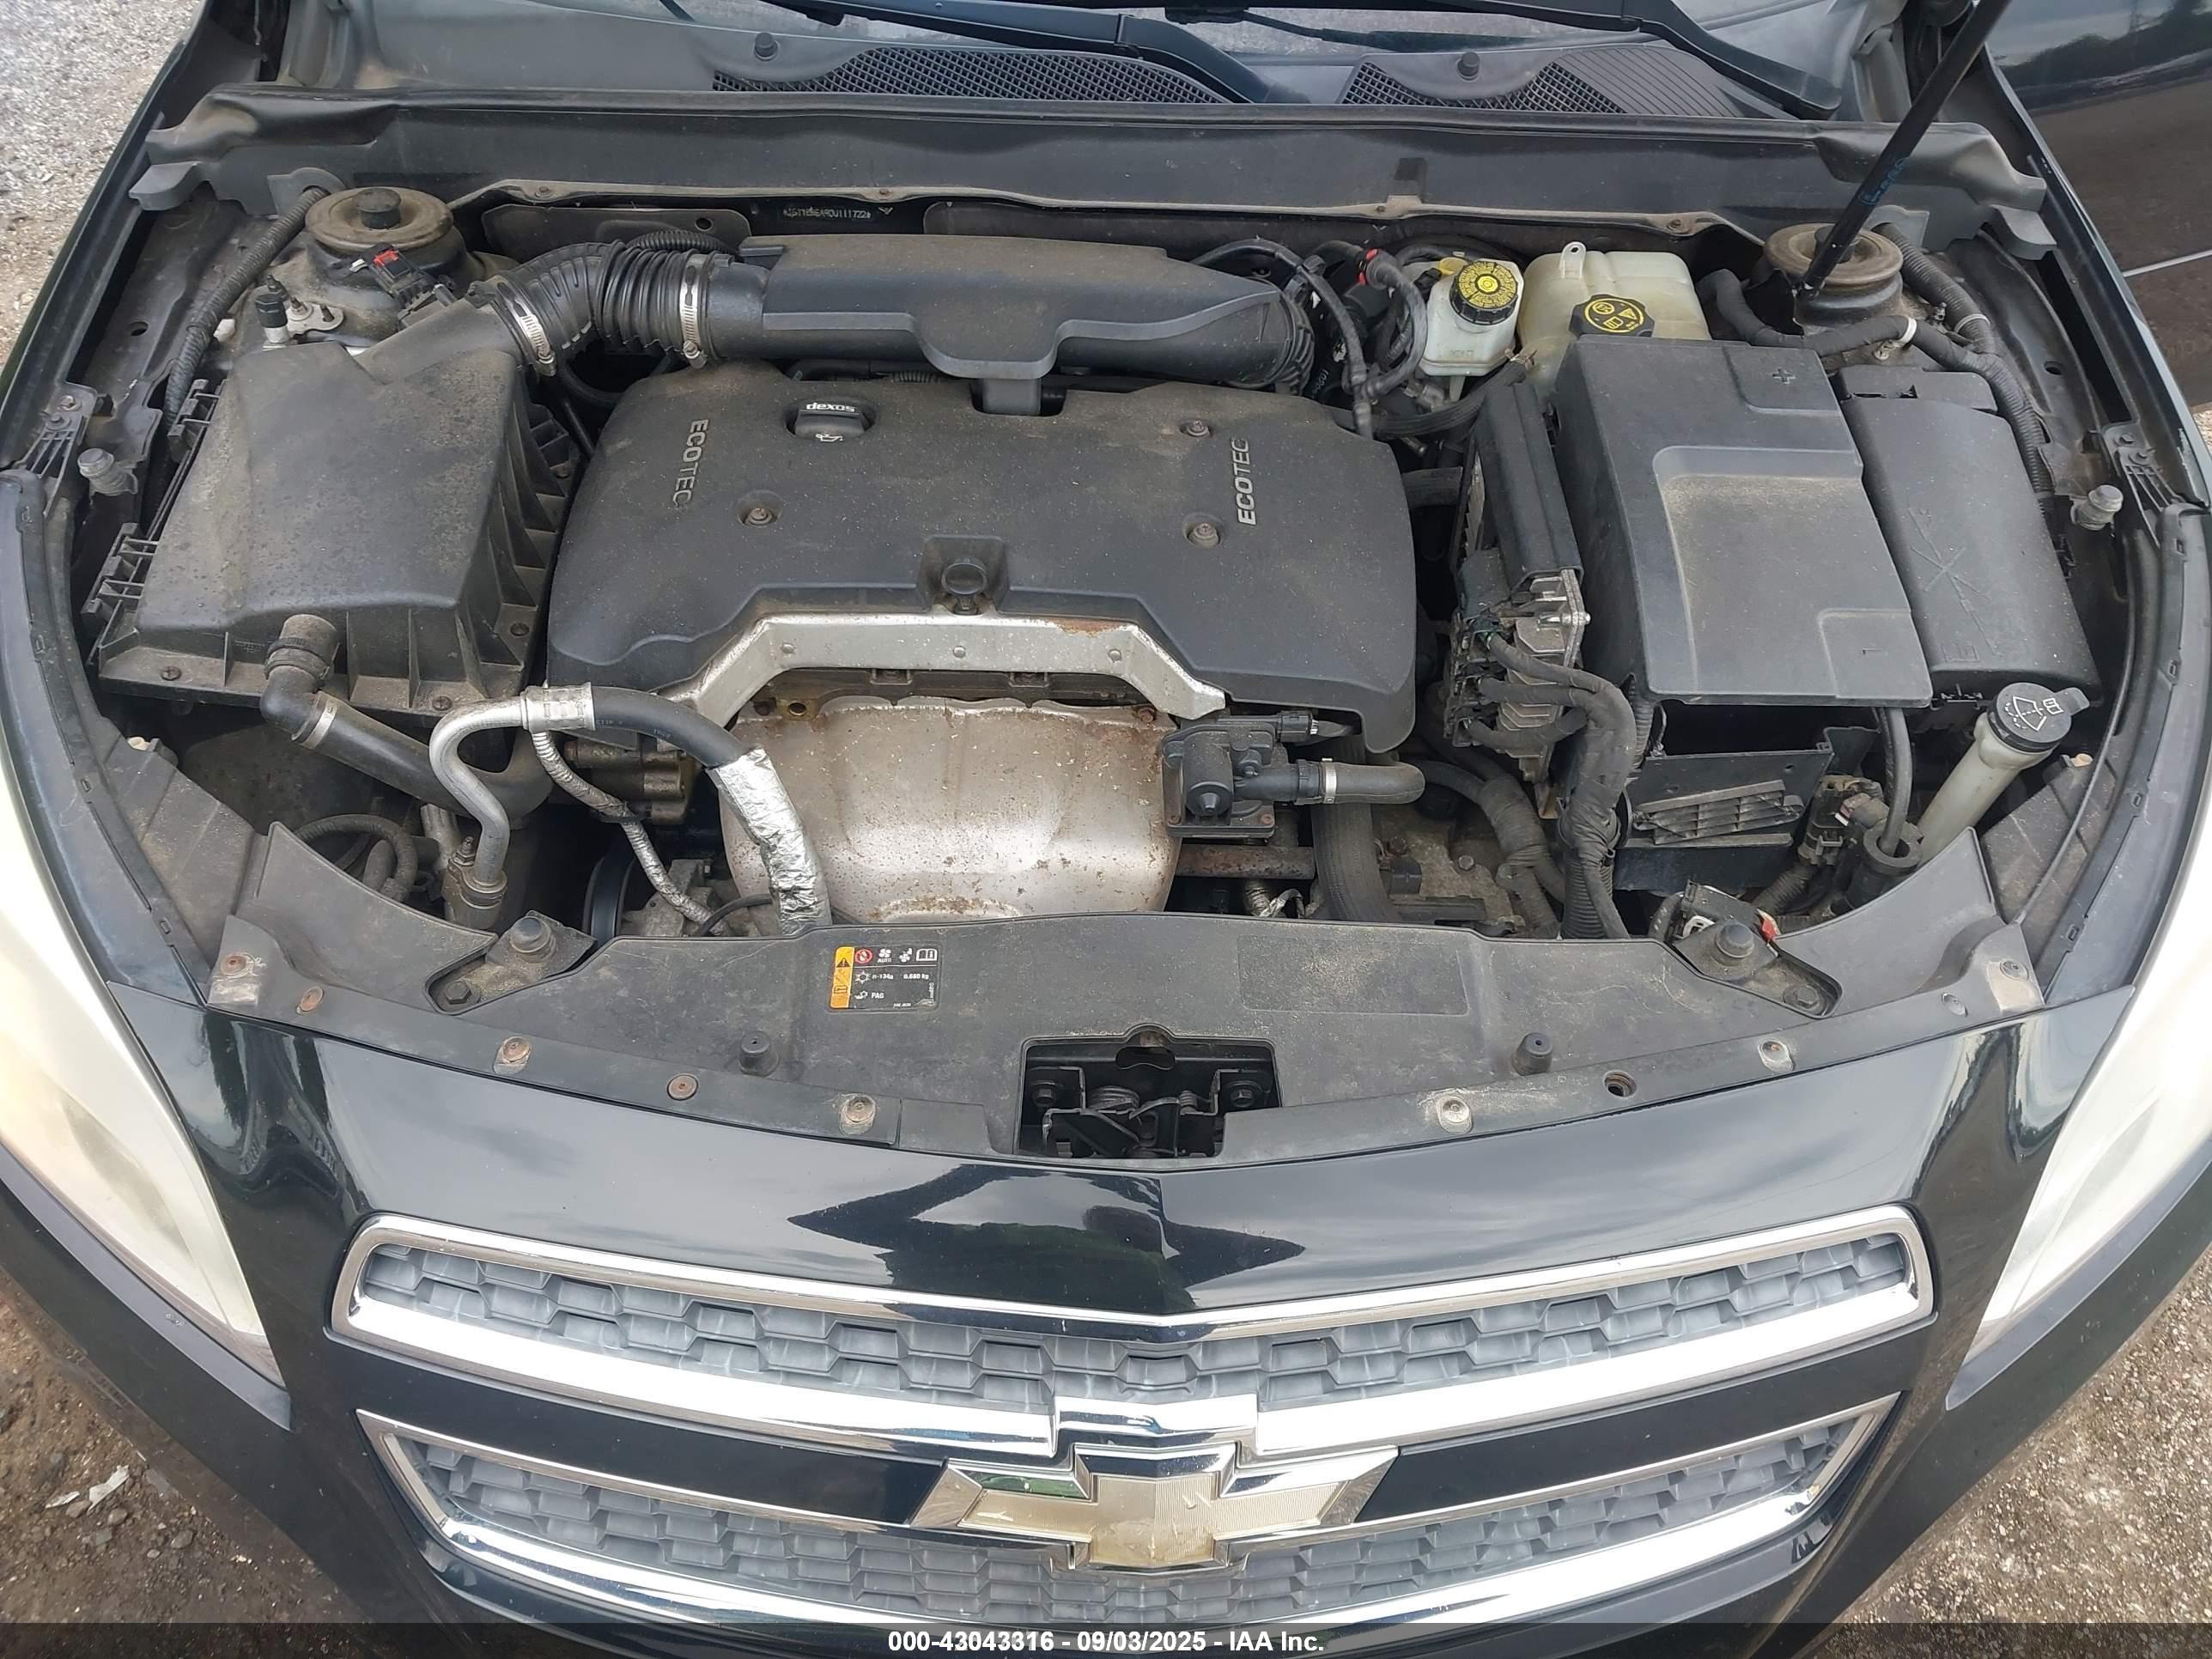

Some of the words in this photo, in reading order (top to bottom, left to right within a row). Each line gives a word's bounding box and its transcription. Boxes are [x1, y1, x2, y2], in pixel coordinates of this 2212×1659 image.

[805, 402, 855, 412] dexos
[672, 419, 709, 507] ECOTEC
[1231, 436, 1257, 526] ECOTEC
